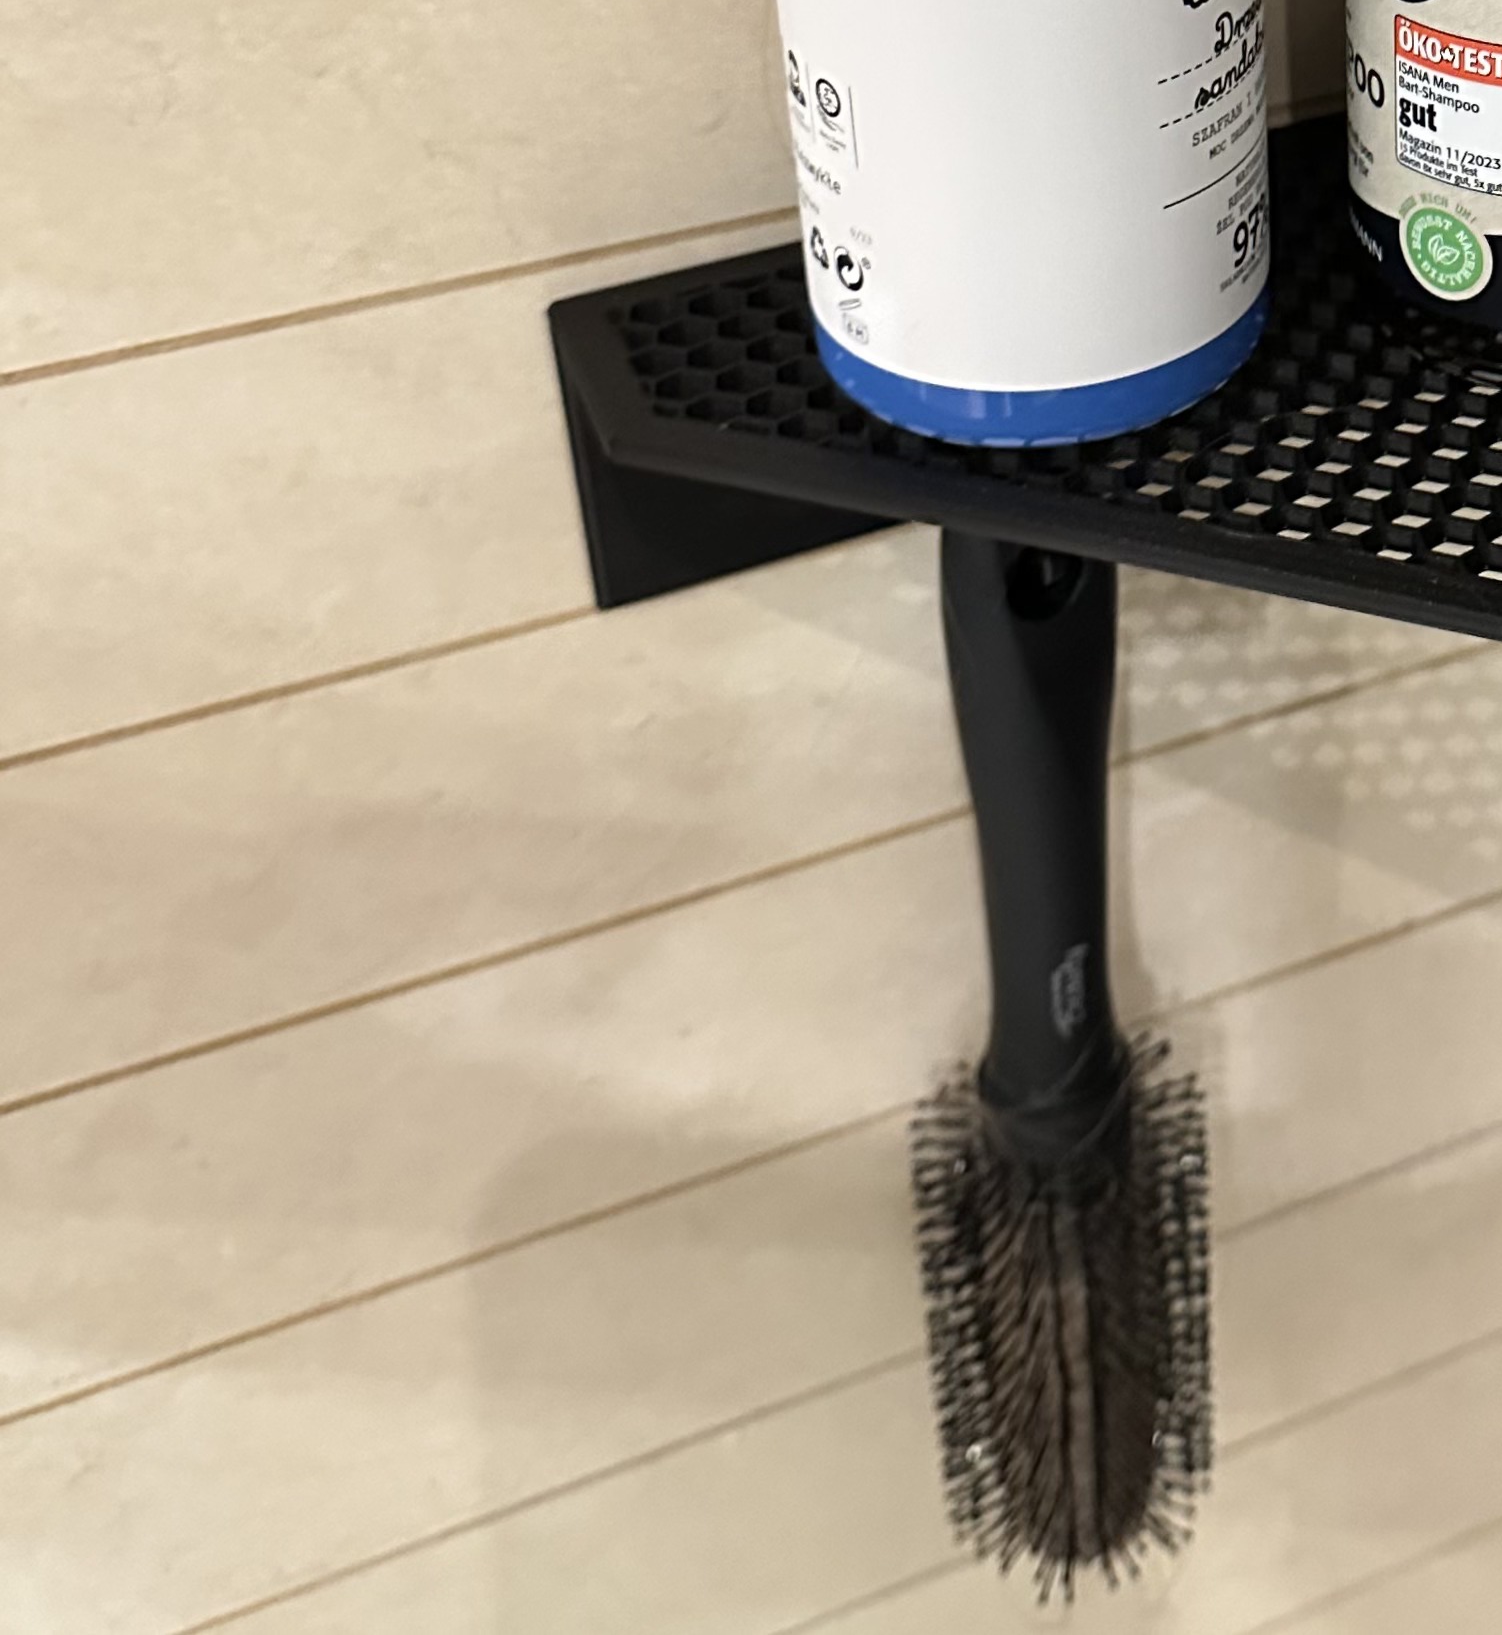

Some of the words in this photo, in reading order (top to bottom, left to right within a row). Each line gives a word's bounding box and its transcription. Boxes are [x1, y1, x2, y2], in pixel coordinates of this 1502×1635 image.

[1399, 60, 1430, 84] ISANA
[1433, 75, 1460, 94] Men
[1399, 75, 1480, 114] Bart-Shampoo
[1192, 101, 1243, 147] SZAFRAN
[1399, 97, 1437, 133] gut
[1209, 139, 1227, 159] MOC
[1399, 127, 1442, 155] Magazin
[1446, 146, 1502, 170] 11/2023
[1461, 164, 1478, 178] Test
